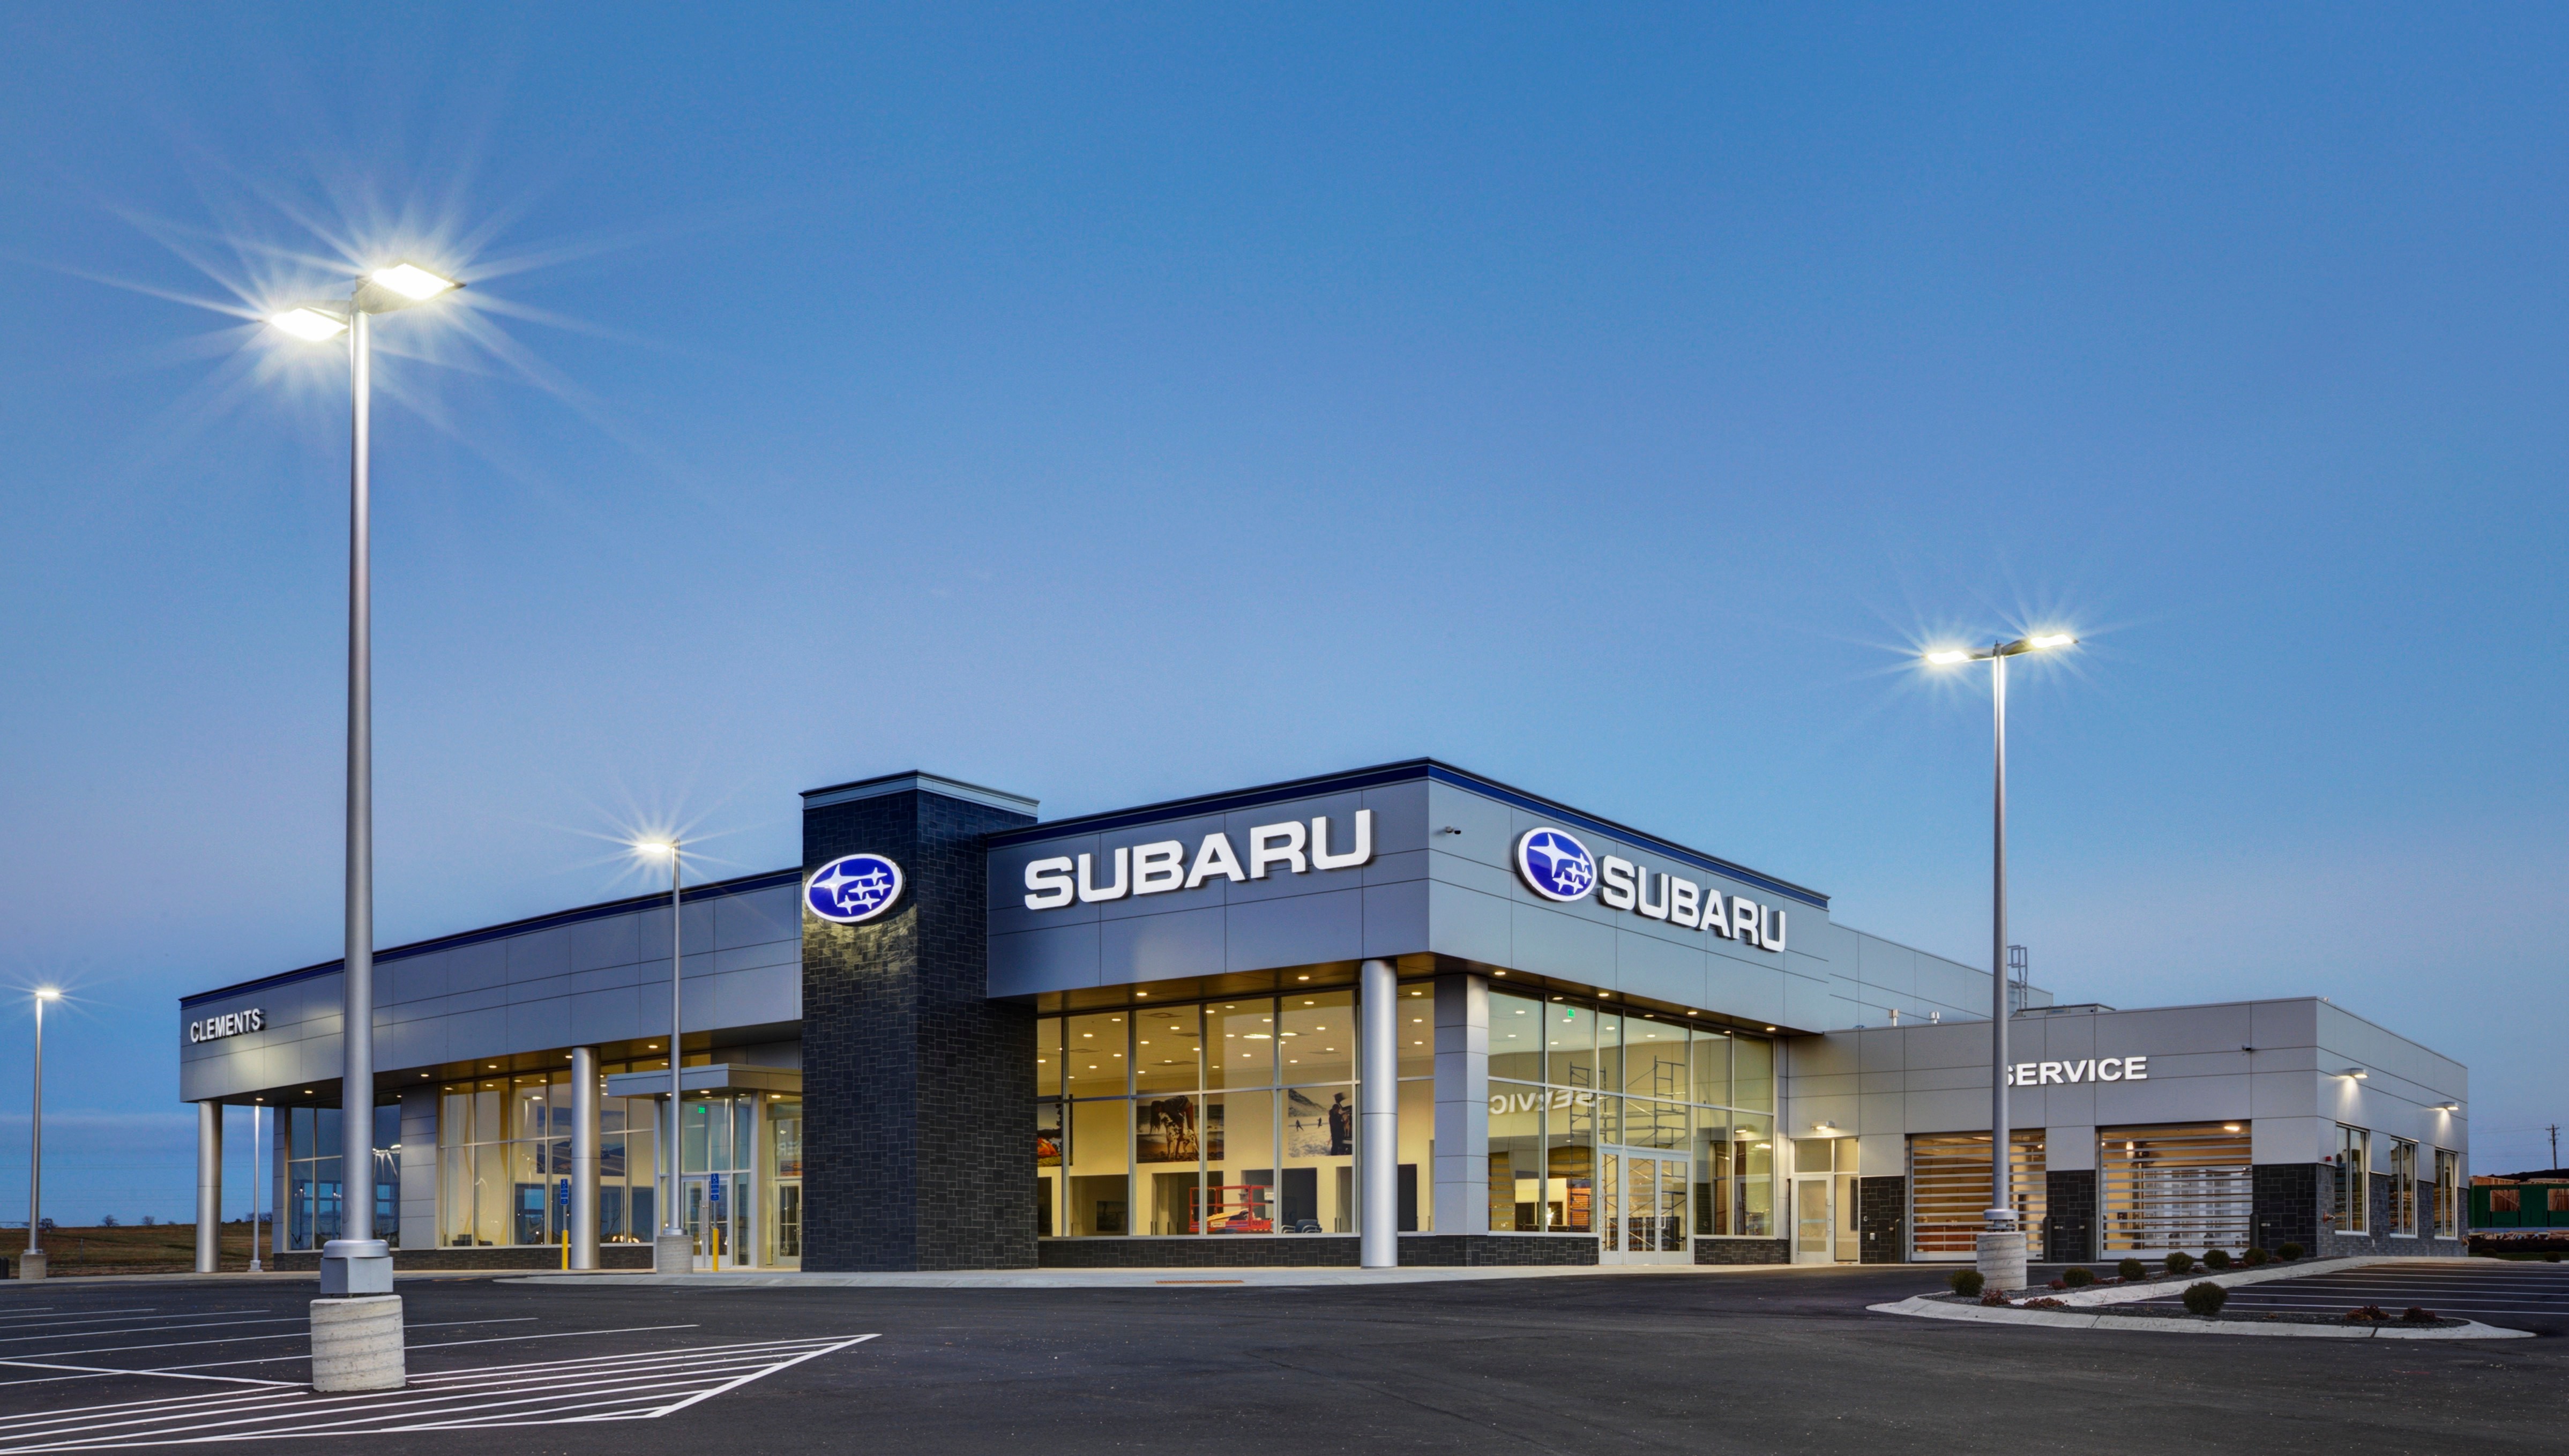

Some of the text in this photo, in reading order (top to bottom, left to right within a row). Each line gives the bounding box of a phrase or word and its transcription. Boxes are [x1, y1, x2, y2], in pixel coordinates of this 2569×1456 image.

[1024, 809, 1372, 910] SUBARU
[1599, 855, 1786, 953] SUBARU
[190, 1007, 261, 1043] CLEMENTS
[2008, 1056, 2148, 1086] ERVICE
